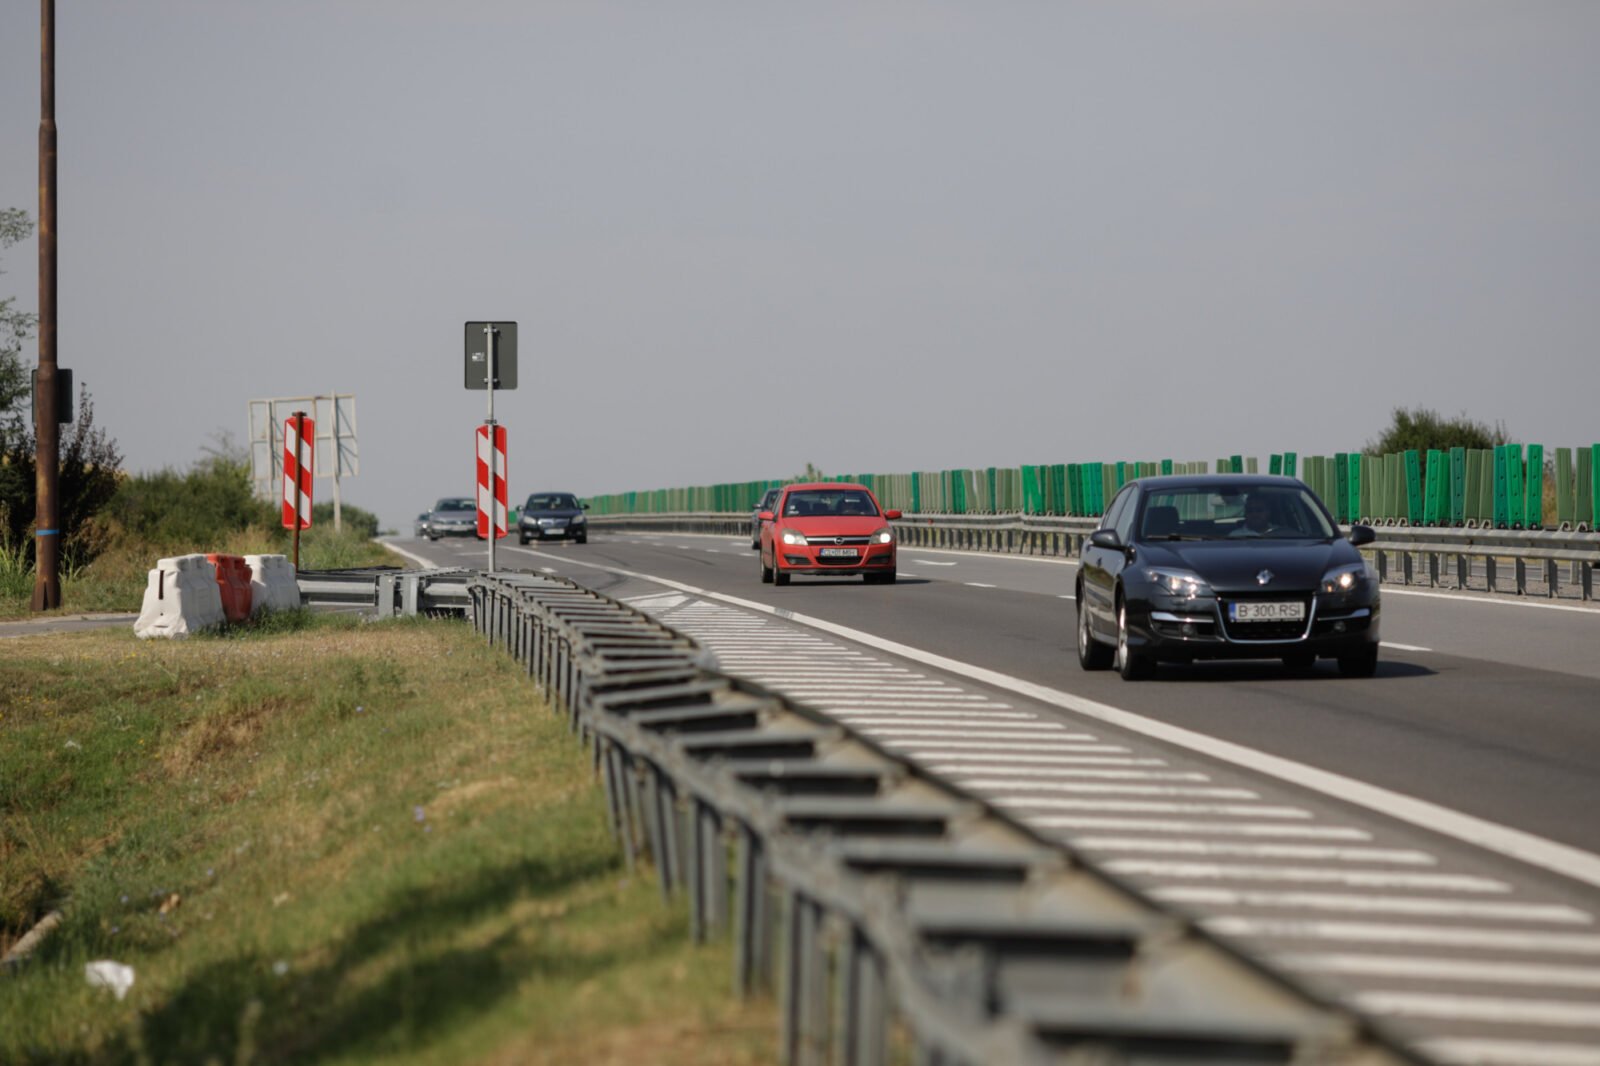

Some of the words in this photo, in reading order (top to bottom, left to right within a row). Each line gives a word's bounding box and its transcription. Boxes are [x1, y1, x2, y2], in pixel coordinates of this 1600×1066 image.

[1239, 605, 1248, 617] B
[1253, 605, 1275, 617] 300
[1279, 604, 1301, 616] RSI
